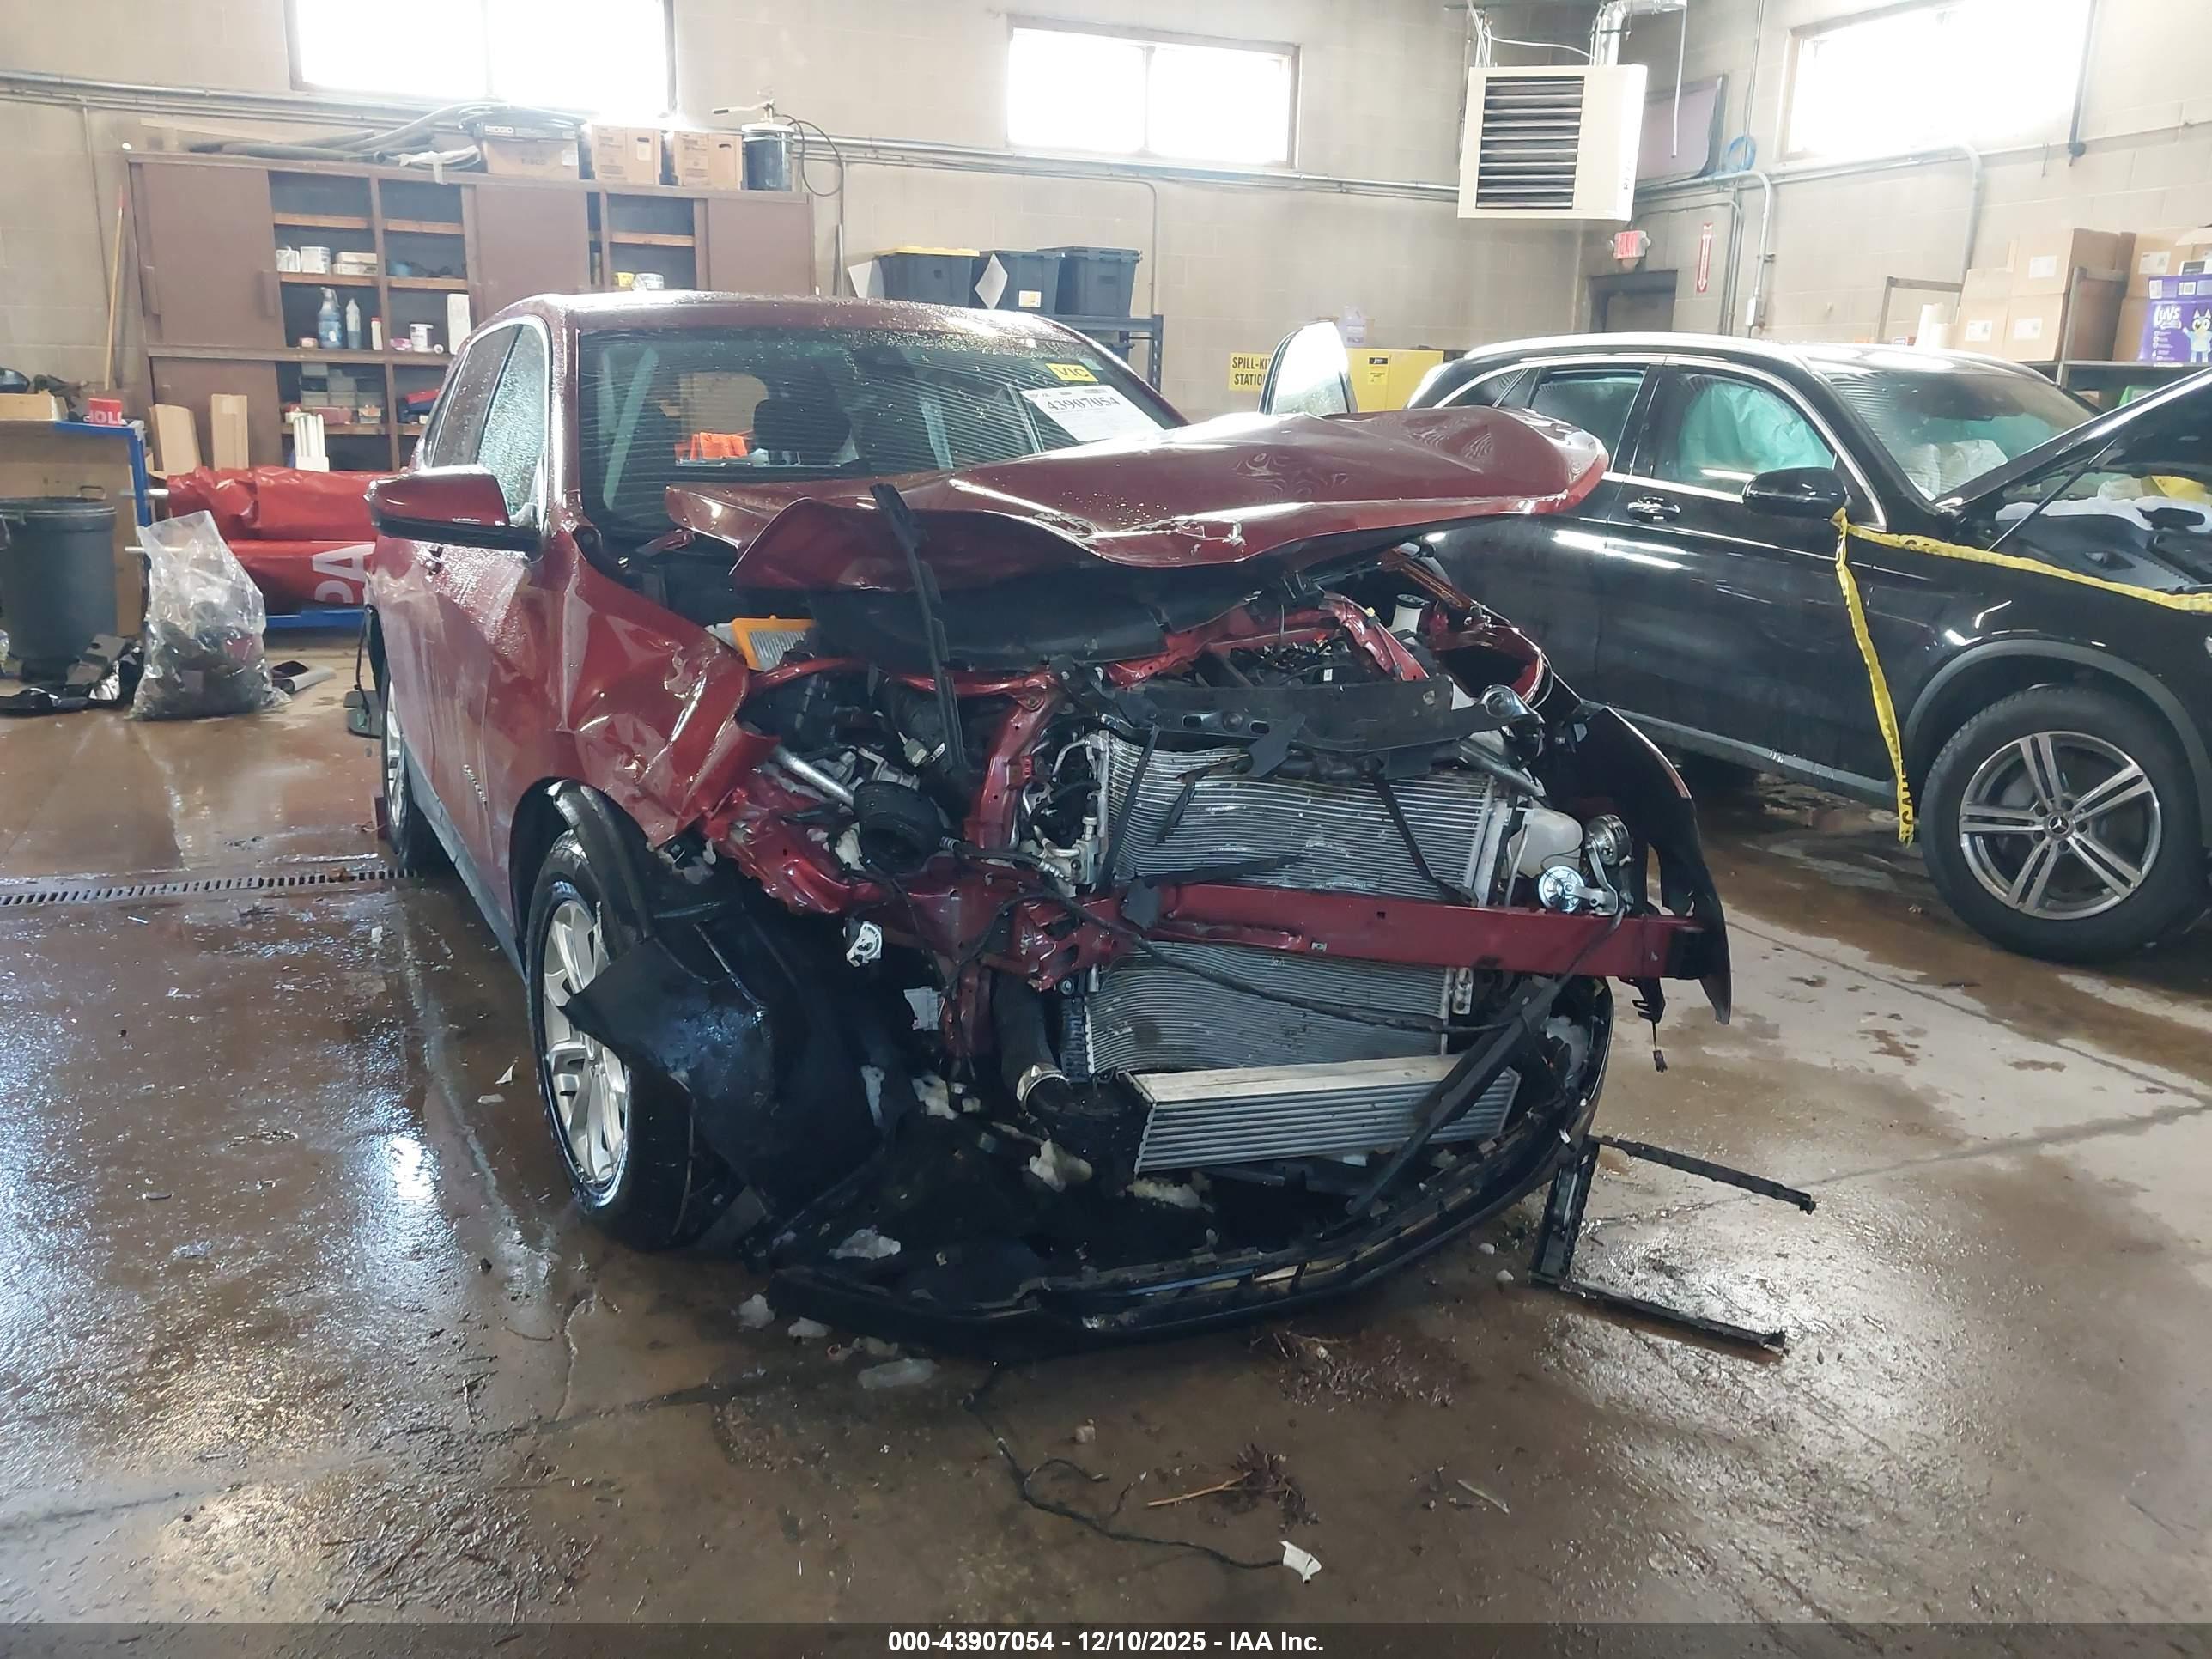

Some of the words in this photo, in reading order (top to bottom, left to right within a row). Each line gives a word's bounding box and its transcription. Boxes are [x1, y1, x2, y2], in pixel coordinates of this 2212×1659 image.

[1054, 367, 1090, 378] VIC
[1234, 373, 1266, 386] STATIO
[1048, 395, 1121, 410] 43907054
